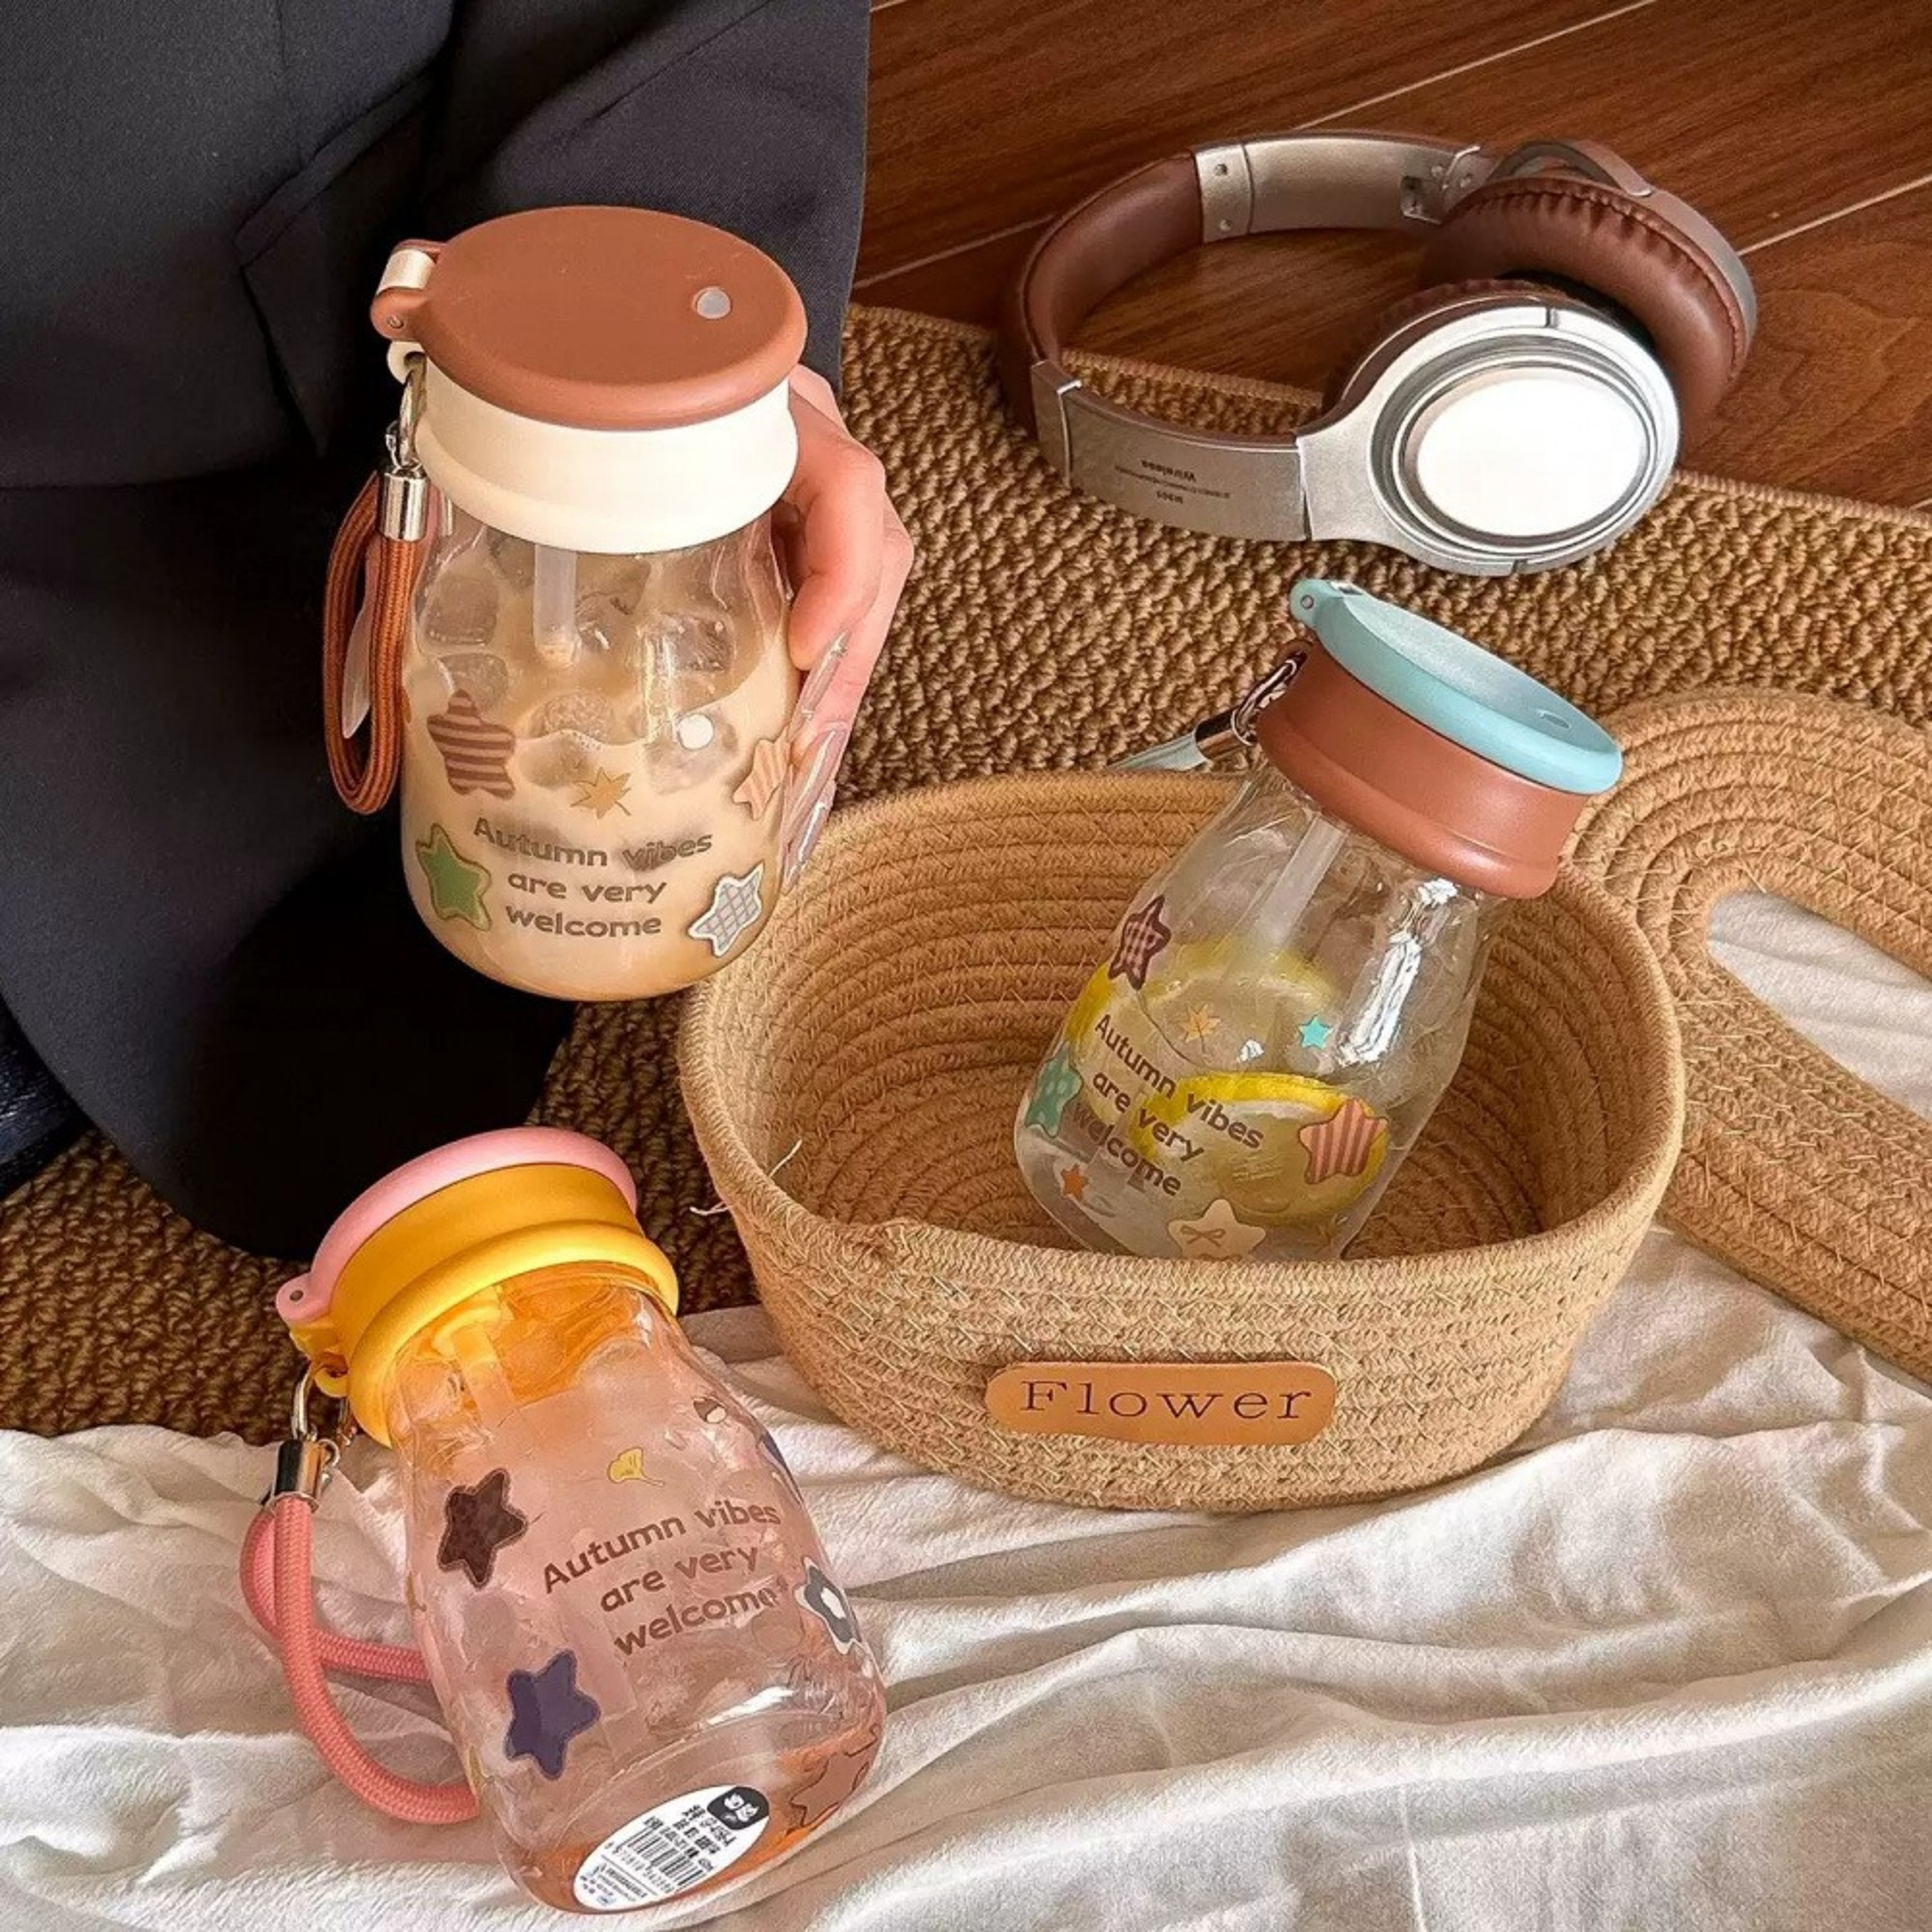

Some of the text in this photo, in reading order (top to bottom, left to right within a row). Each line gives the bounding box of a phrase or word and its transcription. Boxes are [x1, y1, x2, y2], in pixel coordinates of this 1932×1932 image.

[473, 817, 712, 870] Autumn vibes
[506, 906, 661, 937] welcome
[508, 873, 667, 904] are very
[1095, 1014, 1264, 1149] Autumn vibes
[1074, 1104, 1181, 1196] welcome
[1093, 1072, 1204, 1162] are very
[1020, 1381, 1312, 1419] Flower
[543, 1500, 781, 1594] Autumn vibes
[600, 1546, 758, 1612] are very
